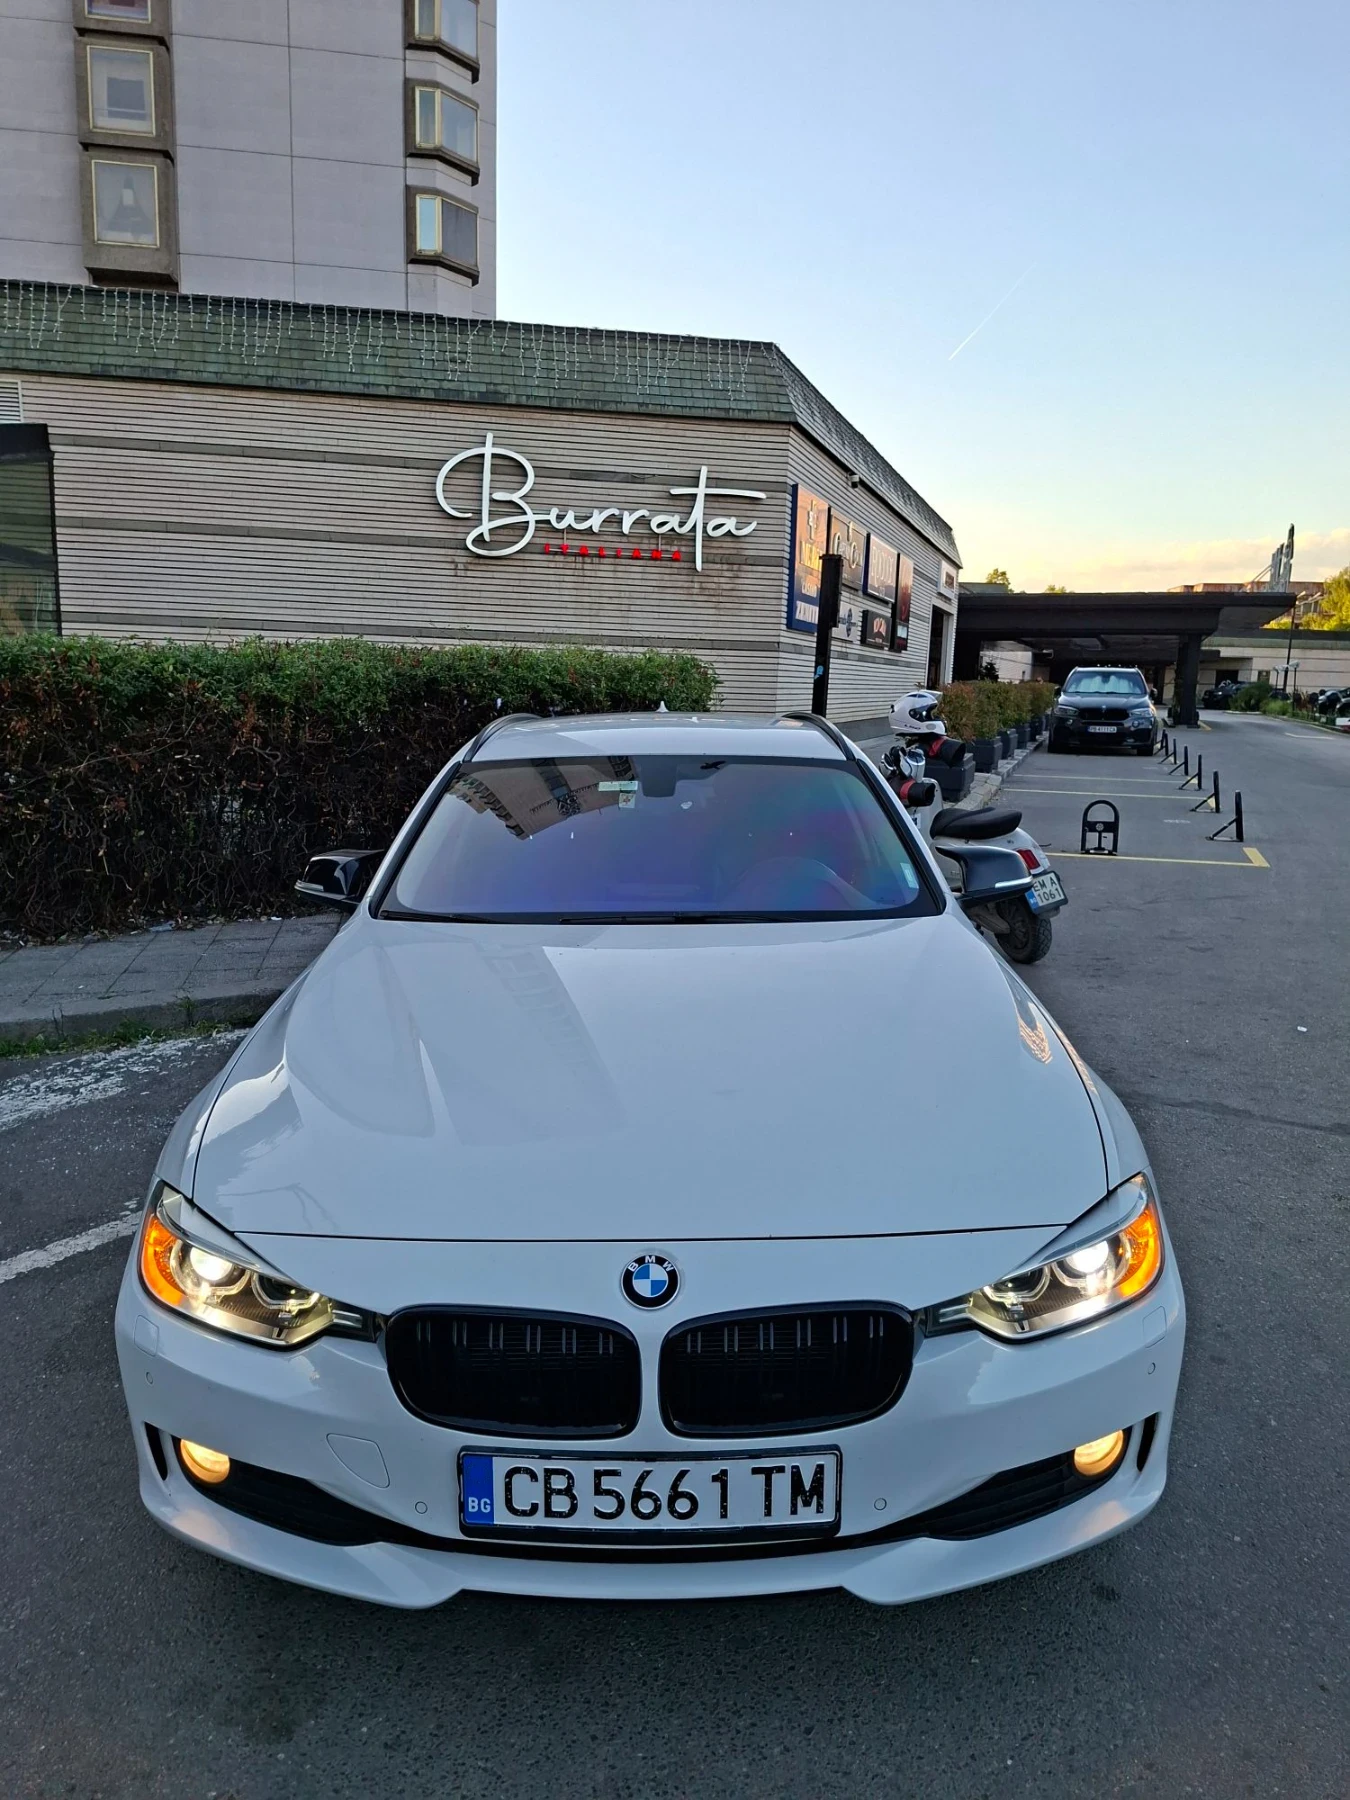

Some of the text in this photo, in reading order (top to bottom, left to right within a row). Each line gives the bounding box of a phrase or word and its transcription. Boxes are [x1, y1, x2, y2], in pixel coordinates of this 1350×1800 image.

[435, 432, 767, 573] Burrata
[544, 543, 681, 560] ITALIANA
[1033, 876, 1057, 892] EM A
[1038, 888, 1061, 903] 1061
[627, 1255, 674, 1272] BMW
[504, 1463, 825, 1520] CB 5661 TM
[468, 1497, 491, 1513] BG
